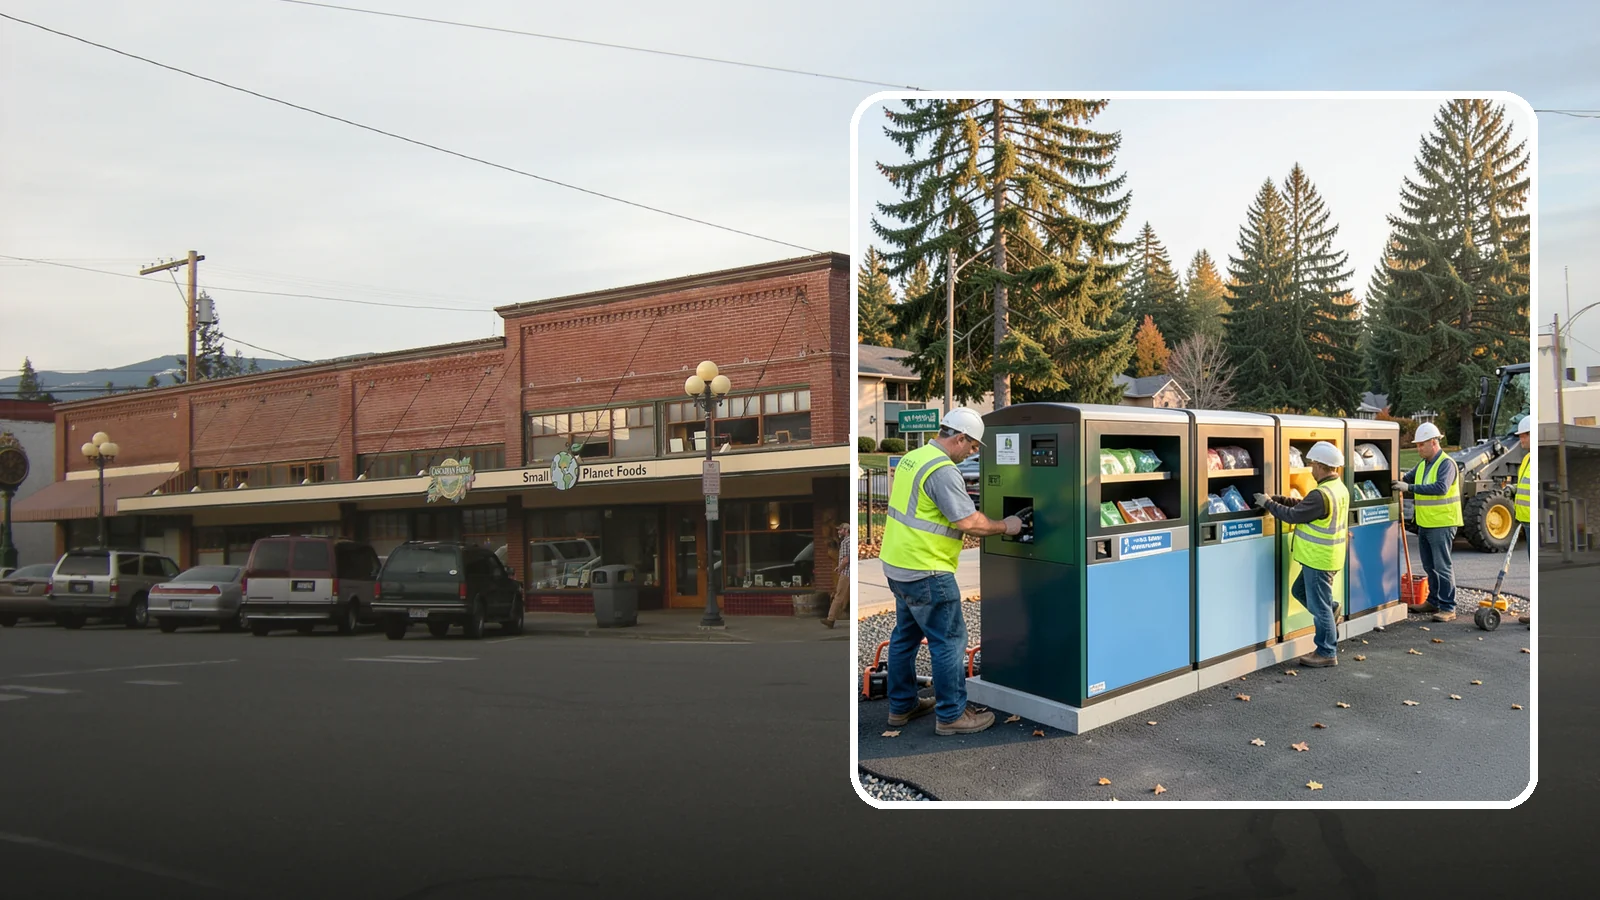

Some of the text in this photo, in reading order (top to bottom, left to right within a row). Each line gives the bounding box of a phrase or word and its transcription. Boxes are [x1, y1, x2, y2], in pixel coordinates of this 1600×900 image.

[523, 464, 647, 483] Small Planet Foods
